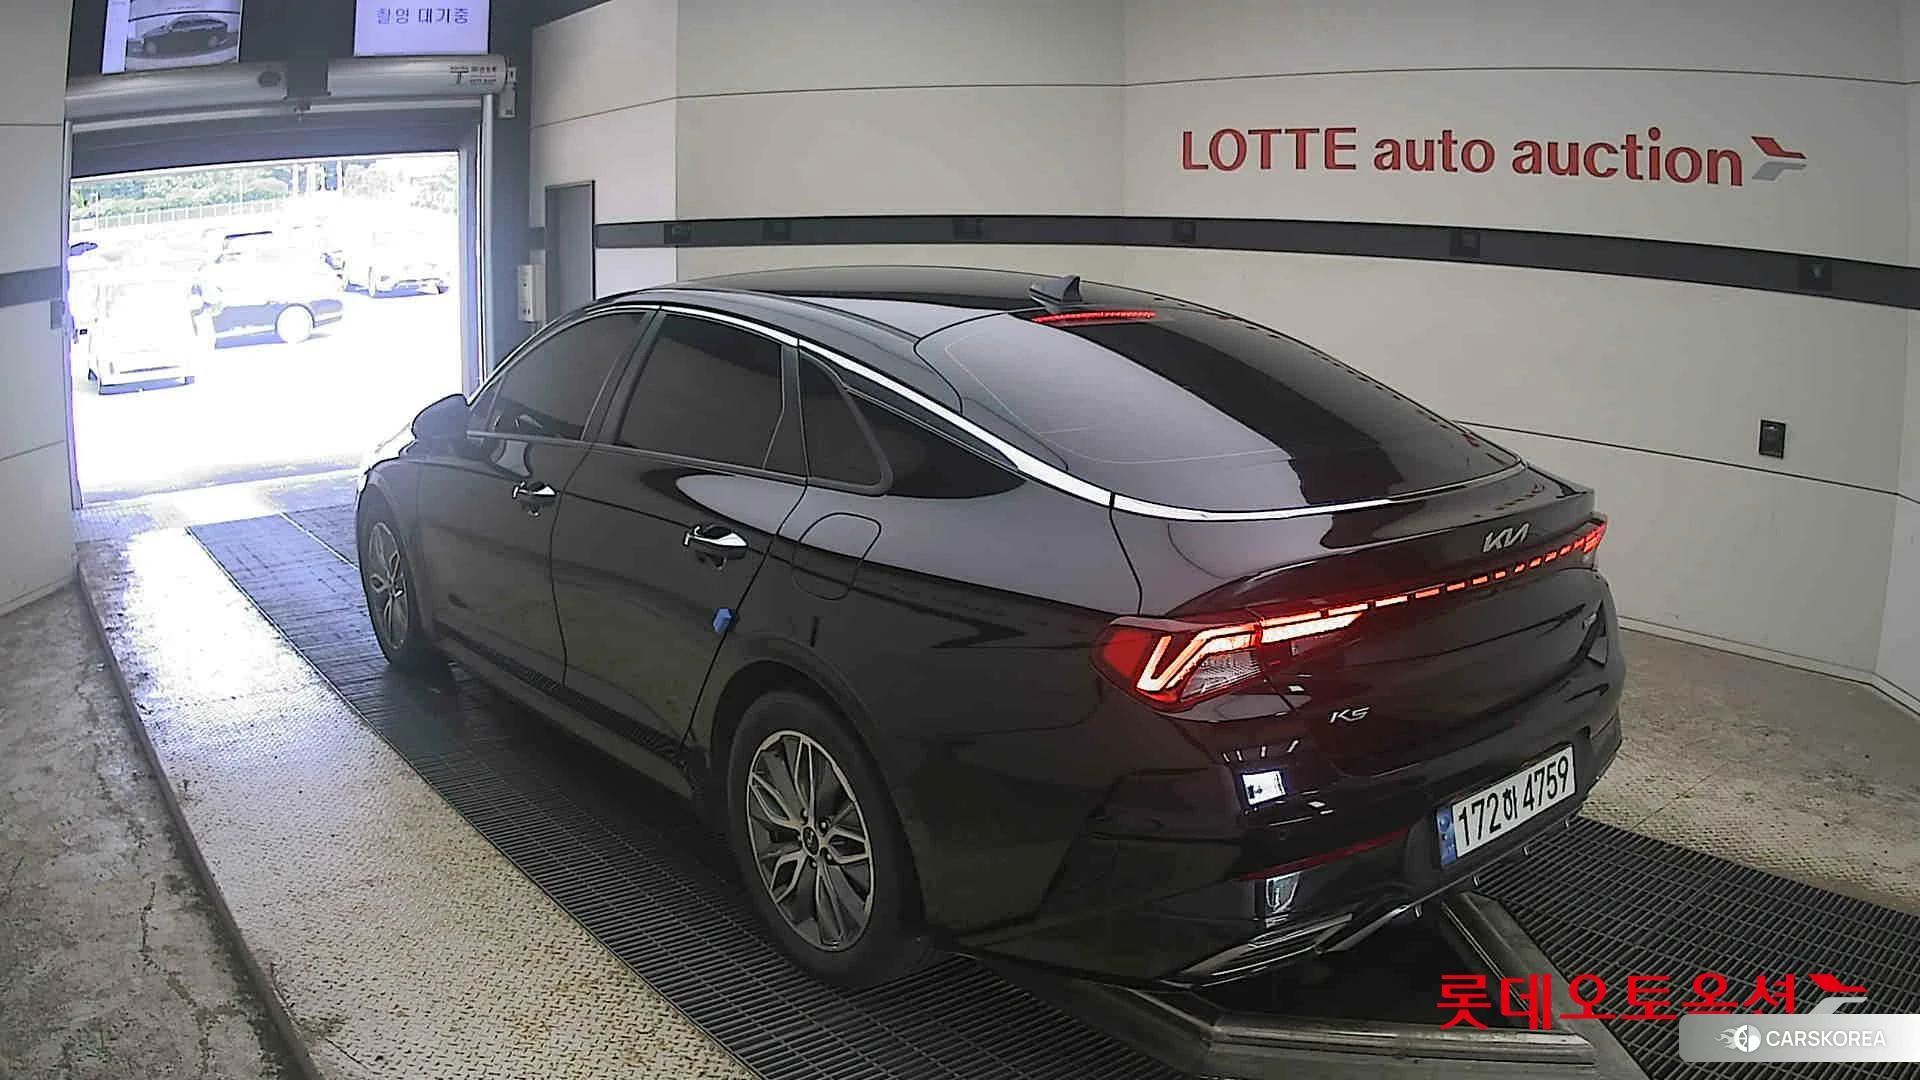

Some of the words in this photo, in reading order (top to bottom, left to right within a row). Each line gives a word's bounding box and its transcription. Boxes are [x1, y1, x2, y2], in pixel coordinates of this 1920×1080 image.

[418, 8, 468, 25] 대기중
[1182, 127, 1357, 171] LOTTE
[1374, 129, 1496, 173] auto
[1511, 127, 1744, 187] auction
